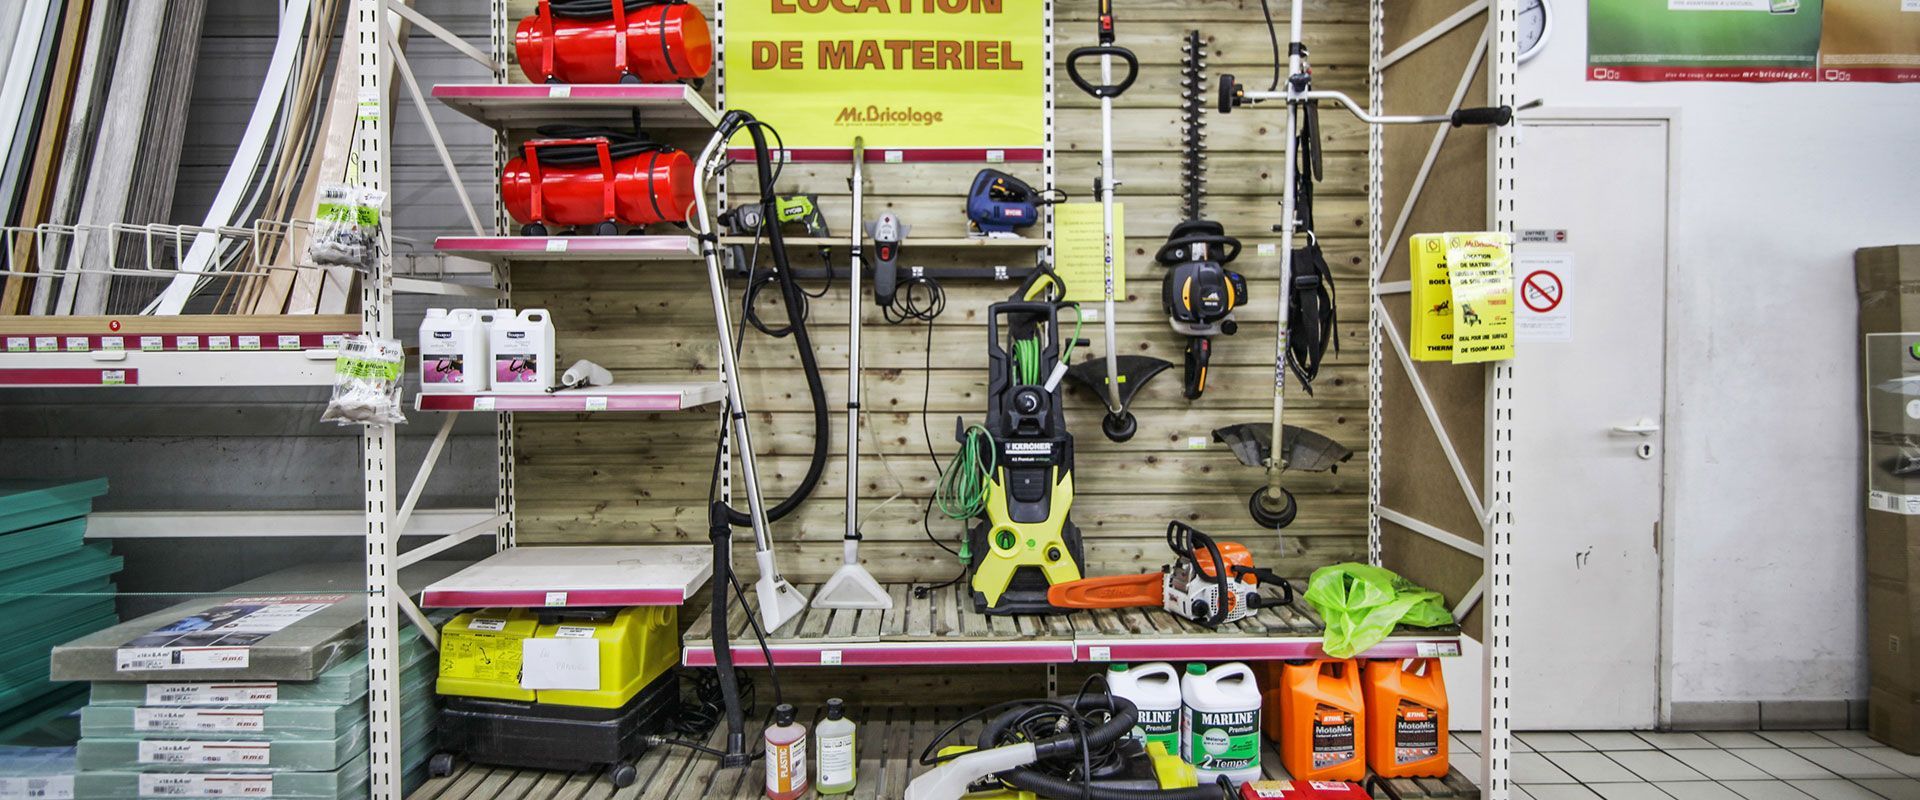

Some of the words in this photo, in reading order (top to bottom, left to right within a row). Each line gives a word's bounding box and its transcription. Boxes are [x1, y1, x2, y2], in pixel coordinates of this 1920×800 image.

[752, 40, 803, 70] DE
[817, 40, 1024, 70] MATERIEL
[834, 105, 943, 126] Mr.Bricolage
[1138, 711, 1172, 723] RLINE
[1201, 711, 1253, 725] MARLINE
[1145, 724, 1172, 732] Premium
[1228, 726, 1254, 734] Premium
[1315, 725, 1352, 735] MotoMix
[1398, 721, 1435, 730] MotoMix
[780, 748, 789, 778] PLASTIC
[1202, 753, 1213, 769] 2
[1215, 759, 1249, 769] Temps
